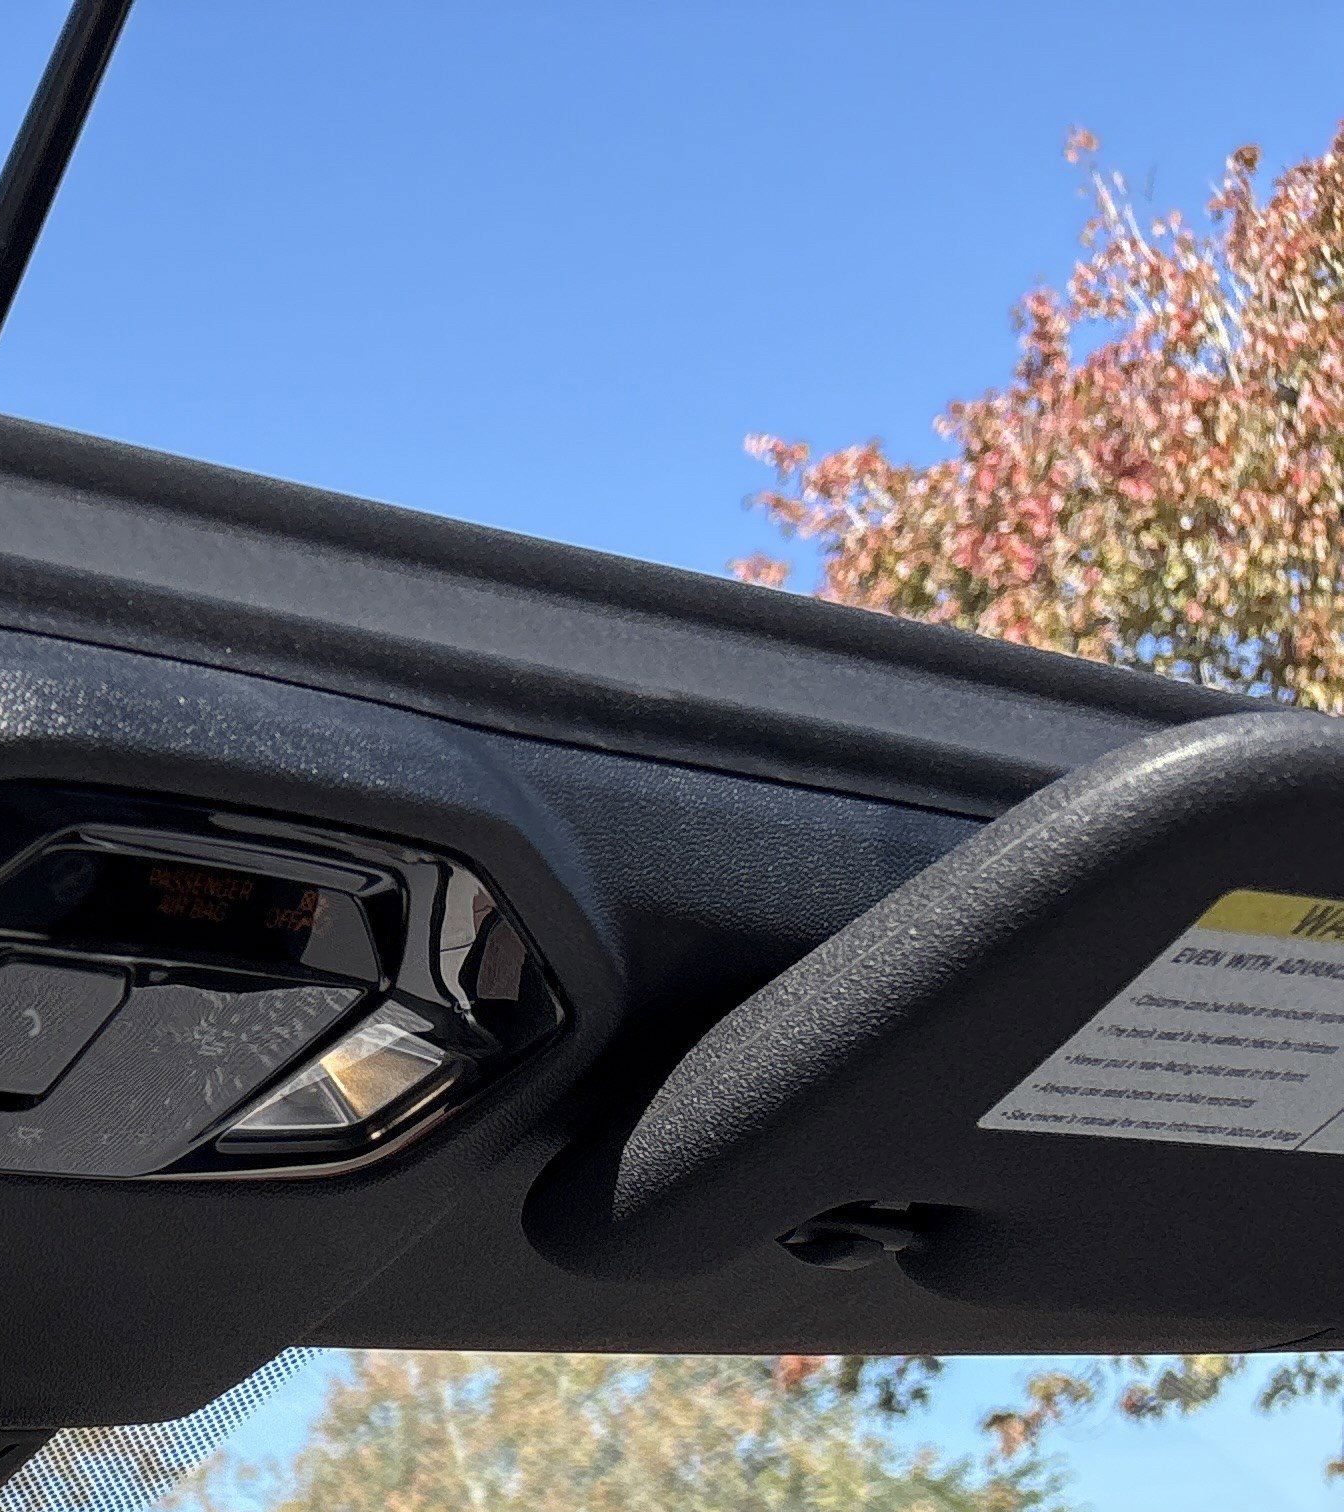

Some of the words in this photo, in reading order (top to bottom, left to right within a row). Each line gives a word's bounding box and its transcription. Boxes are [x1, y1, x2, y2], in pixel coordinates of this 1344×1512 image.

[149, 867, 254, 900] PASSENGER
[190, 898, 230, 922] BAG
[1171, 947, 1227, 966] EVEN
[1223, 953, 1278, 972] WITH
